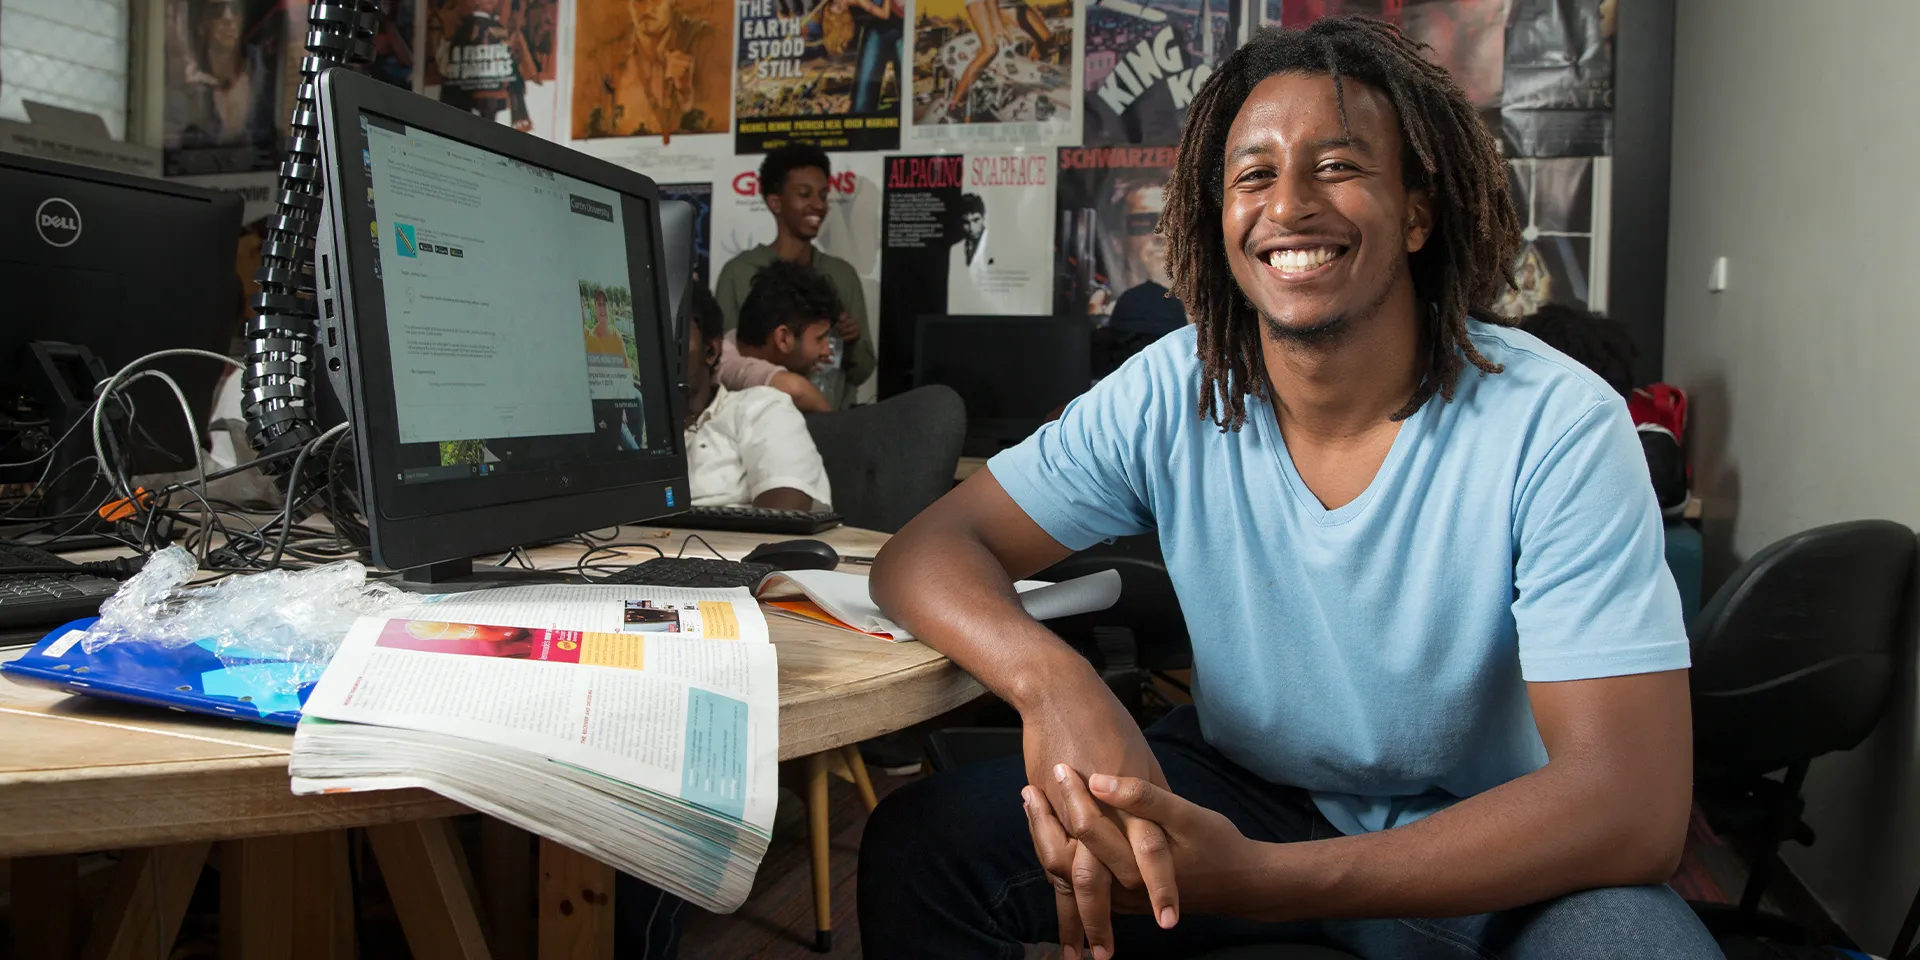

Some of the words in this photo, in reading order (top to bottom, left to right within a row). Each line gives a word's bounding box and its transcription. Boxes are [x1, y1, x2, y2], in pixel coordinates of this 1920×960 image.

[741, 0, 772, 17] THE
[744, 17, 801, 39] EARTH
[748, 38, 805, 59] STOOD
[758, 58, 803, 79] STILL
[1097, 25, 1184, 116] KING
[971, 156, 1047, 187] SCARFACE
[586, 203, 611, 219] University
[41, 214, 77, 230] DELL
